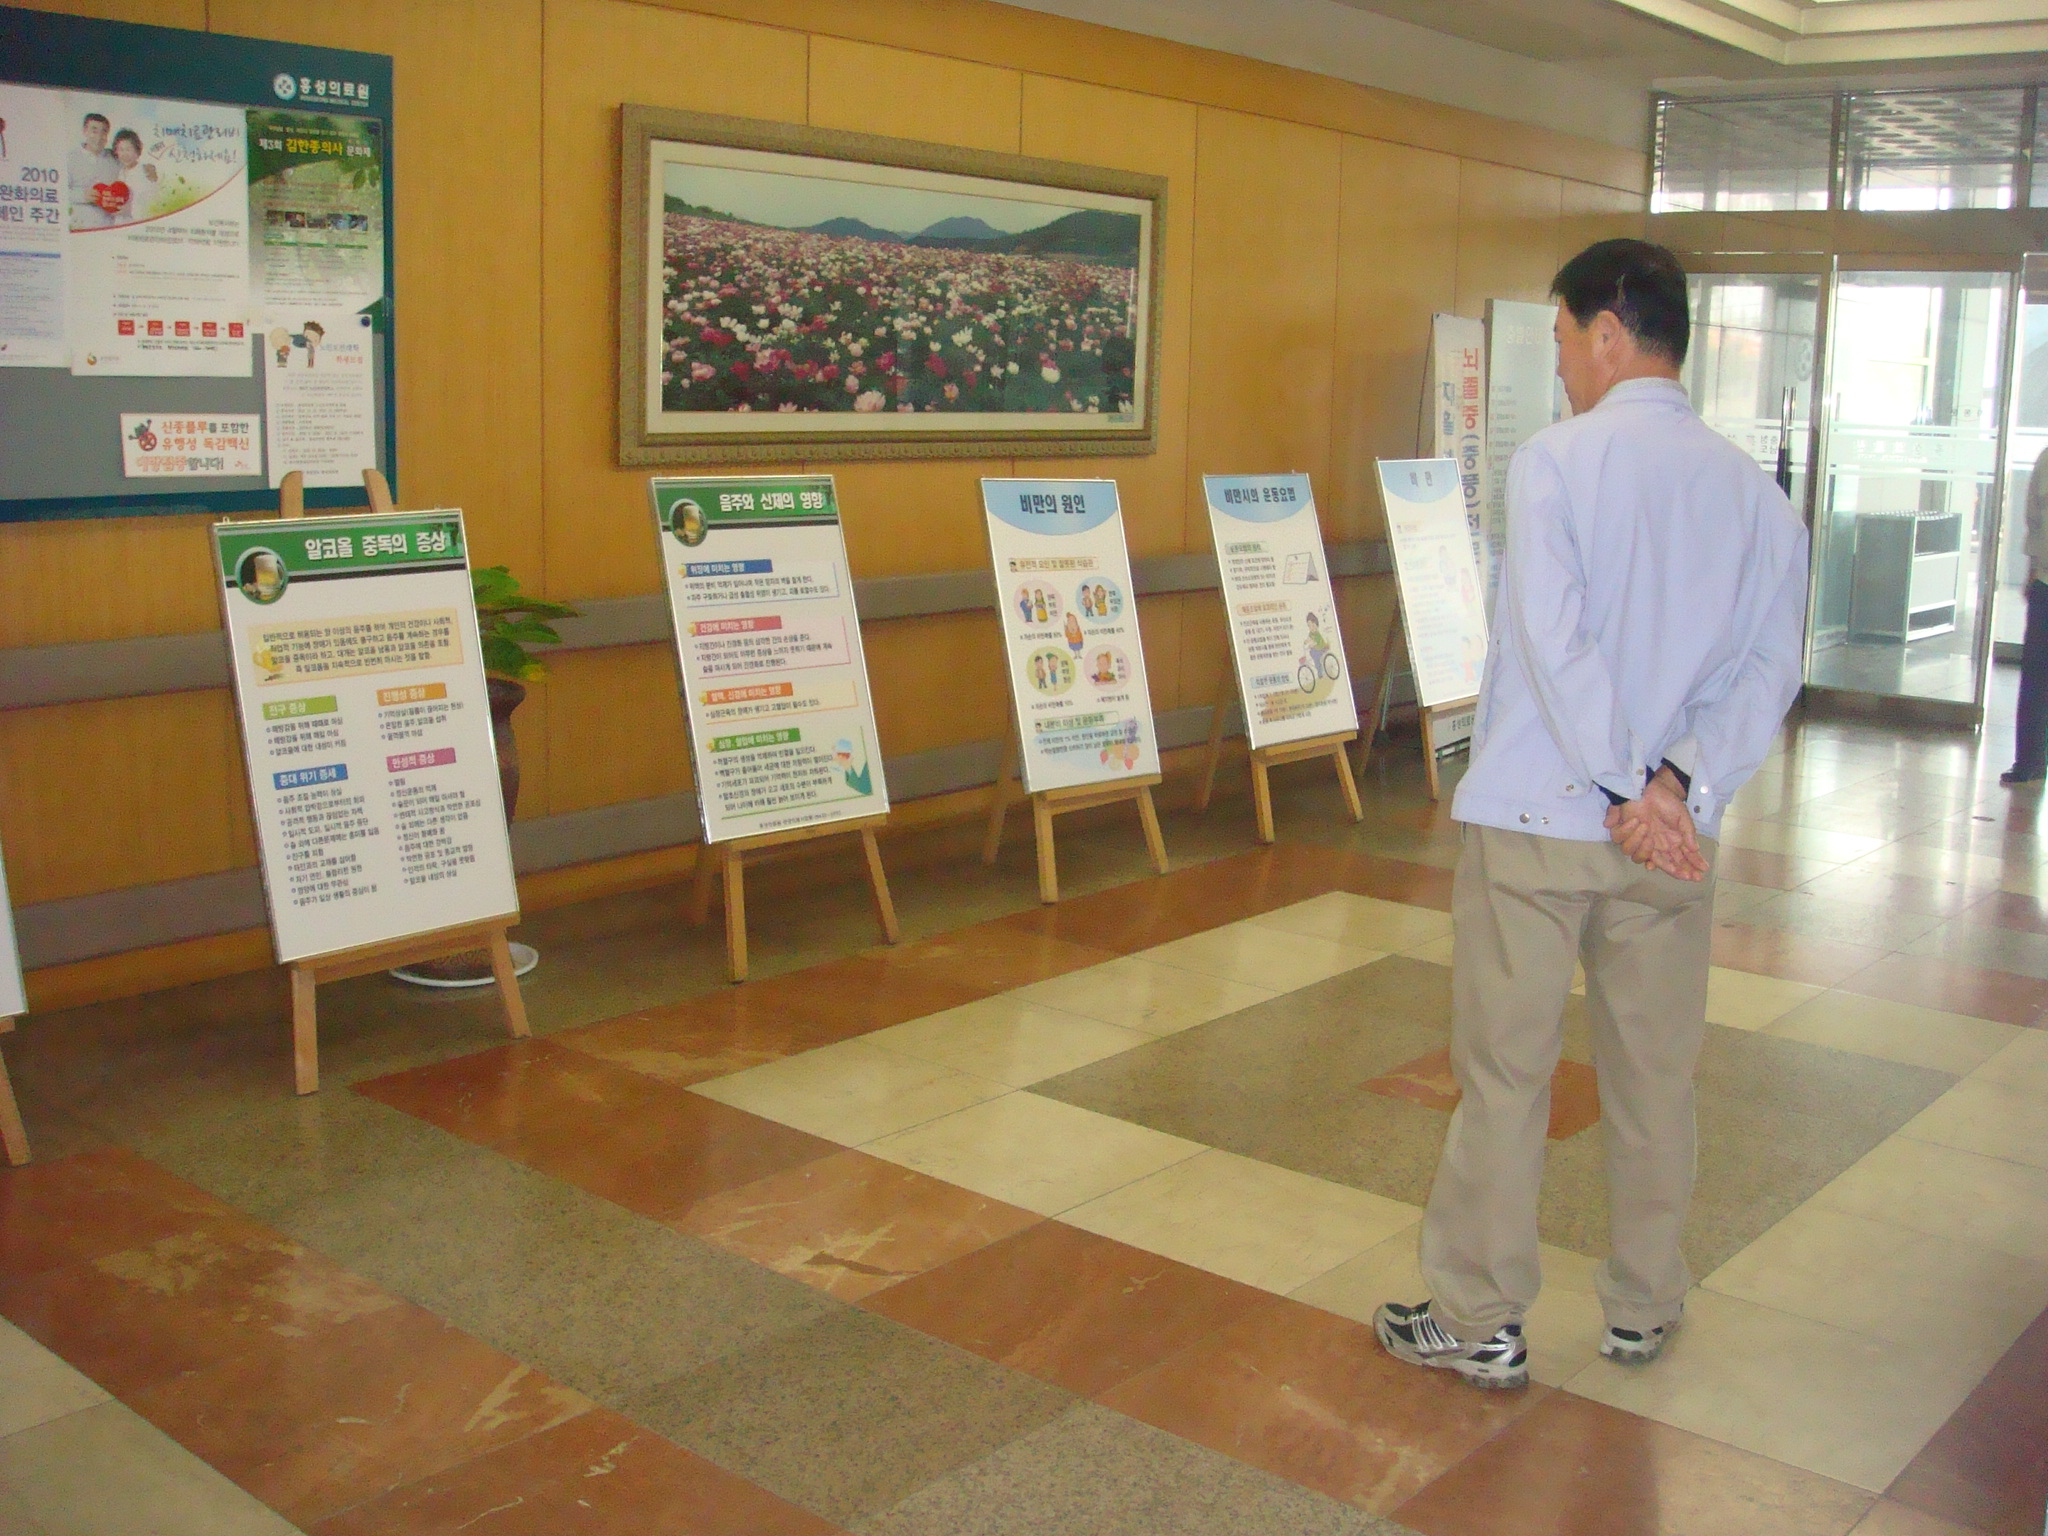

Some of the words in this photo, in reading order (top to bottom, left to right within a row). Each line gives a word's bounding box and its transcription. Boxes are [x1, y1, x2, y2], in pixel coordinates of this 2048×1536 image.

[299, 77, 370, 101] 홍성의료원
[285, 138, 343, 156] 김한종의사
[22, 167, 60, 184] 2010
[30, 208, 60, 224] 주간
[162, 420, 217, 434] 신종플루를
[220, 422, 249, 434] 포함한
[162, 438, 197, 451] 유행성
[203, 438, 249, 451] 독감백신
[719, 493, 753, 511] 음주와
[799, 492, 823, 508] 영향
[1019, 494, 1056, 513] 비만의
[1061, 494, 1085, 513] 원인
[1224, 488, 1258, 503] 비만시의
[1263, 487, 1295, 502] 운동요법
[305, 537, 352, 559] 알코올
[362, 533, 407, 555] 중독의
[416, 531, 447, 551] 증상
[1038, 560, 1049, 568] 요인
